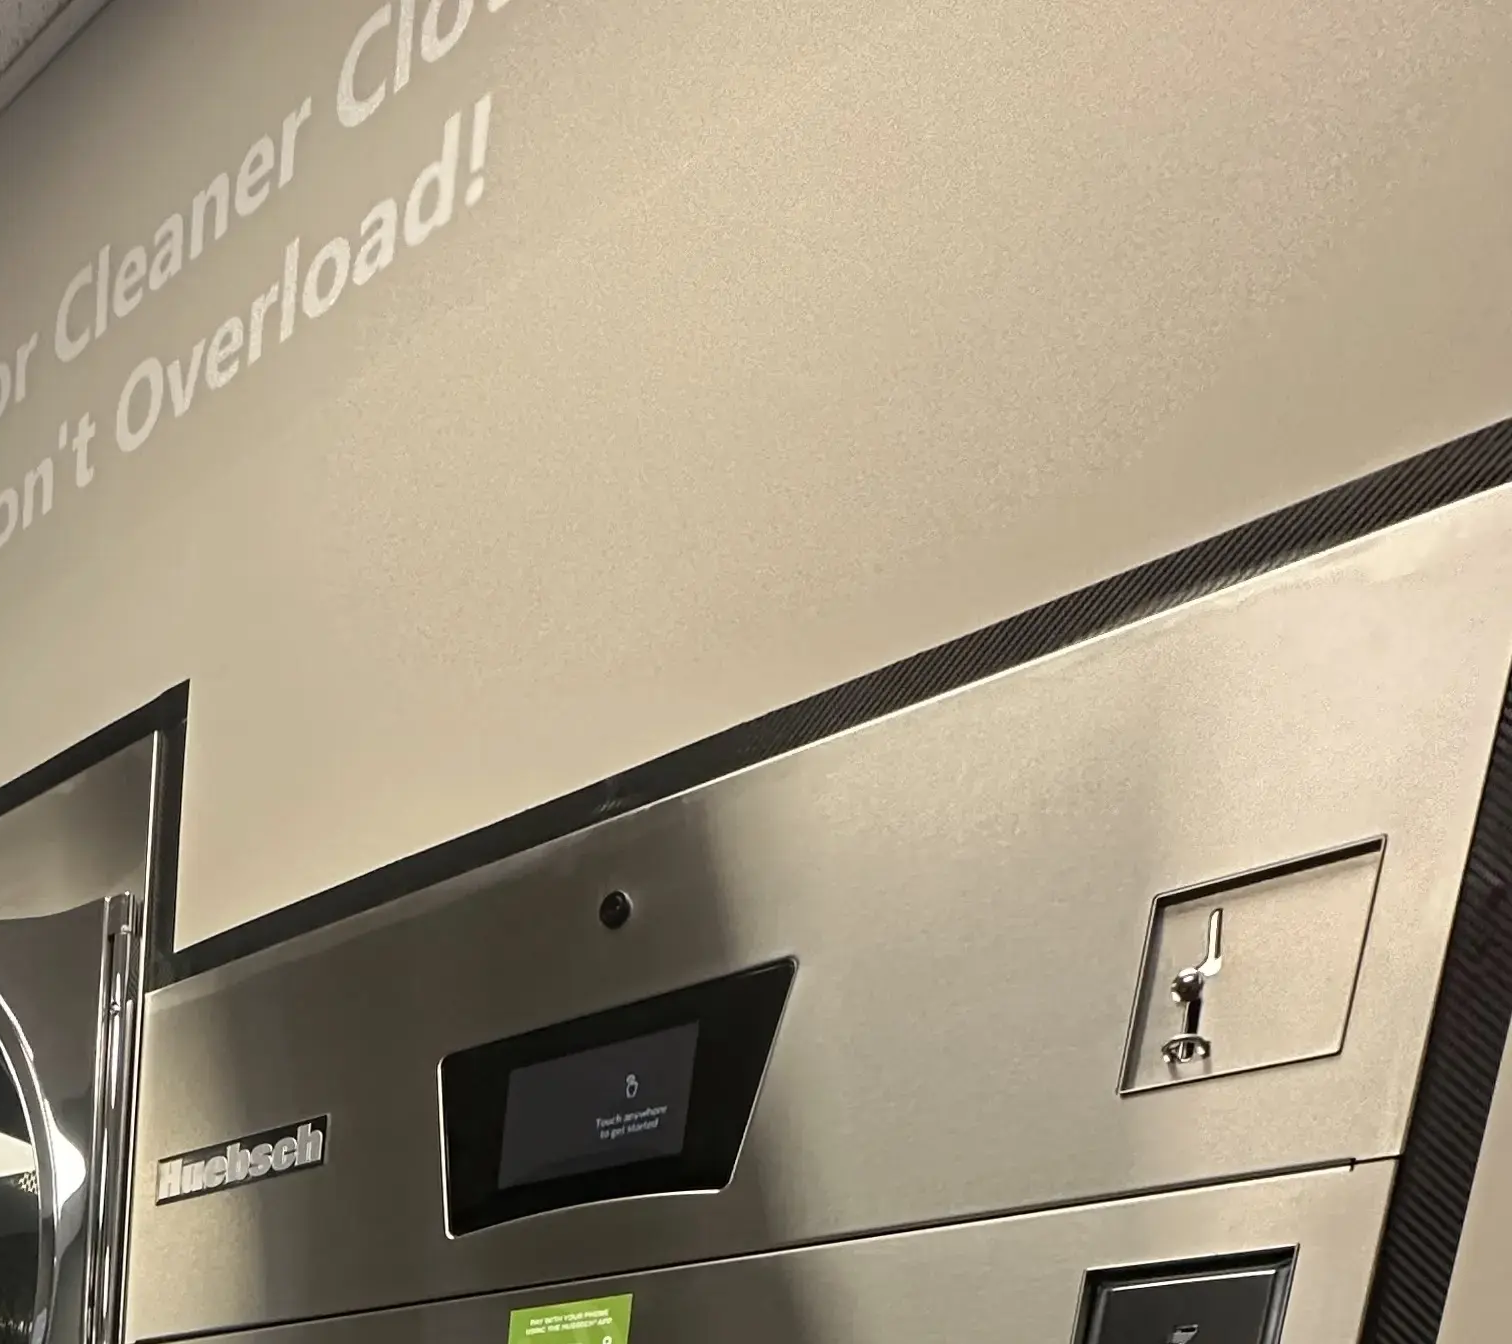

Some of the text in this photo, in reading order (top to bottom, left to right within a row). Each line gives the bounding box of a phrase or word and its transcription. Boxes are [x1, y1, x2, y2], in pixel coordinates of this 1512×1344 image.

[53, 96, 313, 364] Cleaner
[336, 0, 510, 128] Clo
[115, 91, 492, 453] Overload!
[157, 1122, 324, 1201] Huebsch
[596, 1113, 623, 1129] Touch
